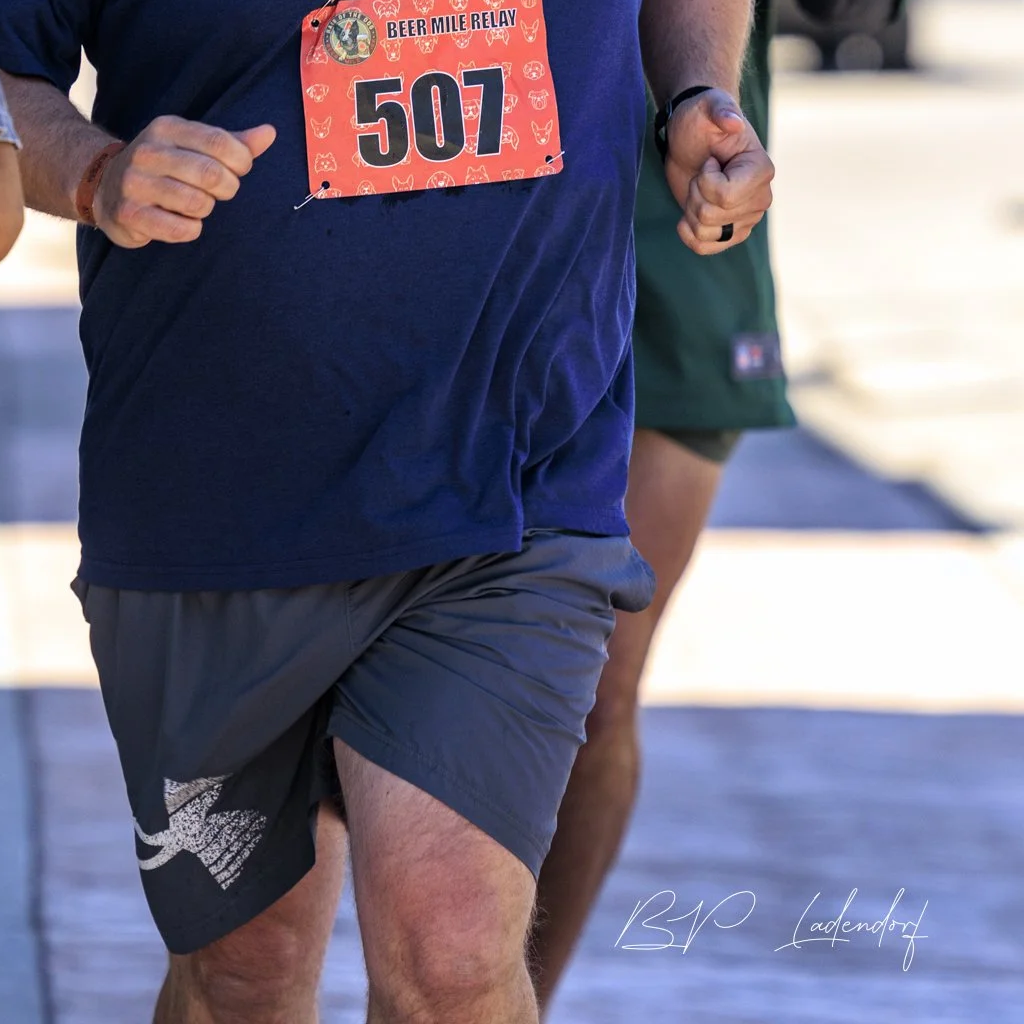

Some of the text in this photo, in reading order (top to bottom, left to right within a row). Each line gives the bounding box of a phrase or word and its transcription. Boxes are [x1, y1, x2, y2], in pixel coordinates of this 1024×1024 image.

[386, 8, 517, 40] BEER MILE RELAY
[354, 66, 505, 168] 507
